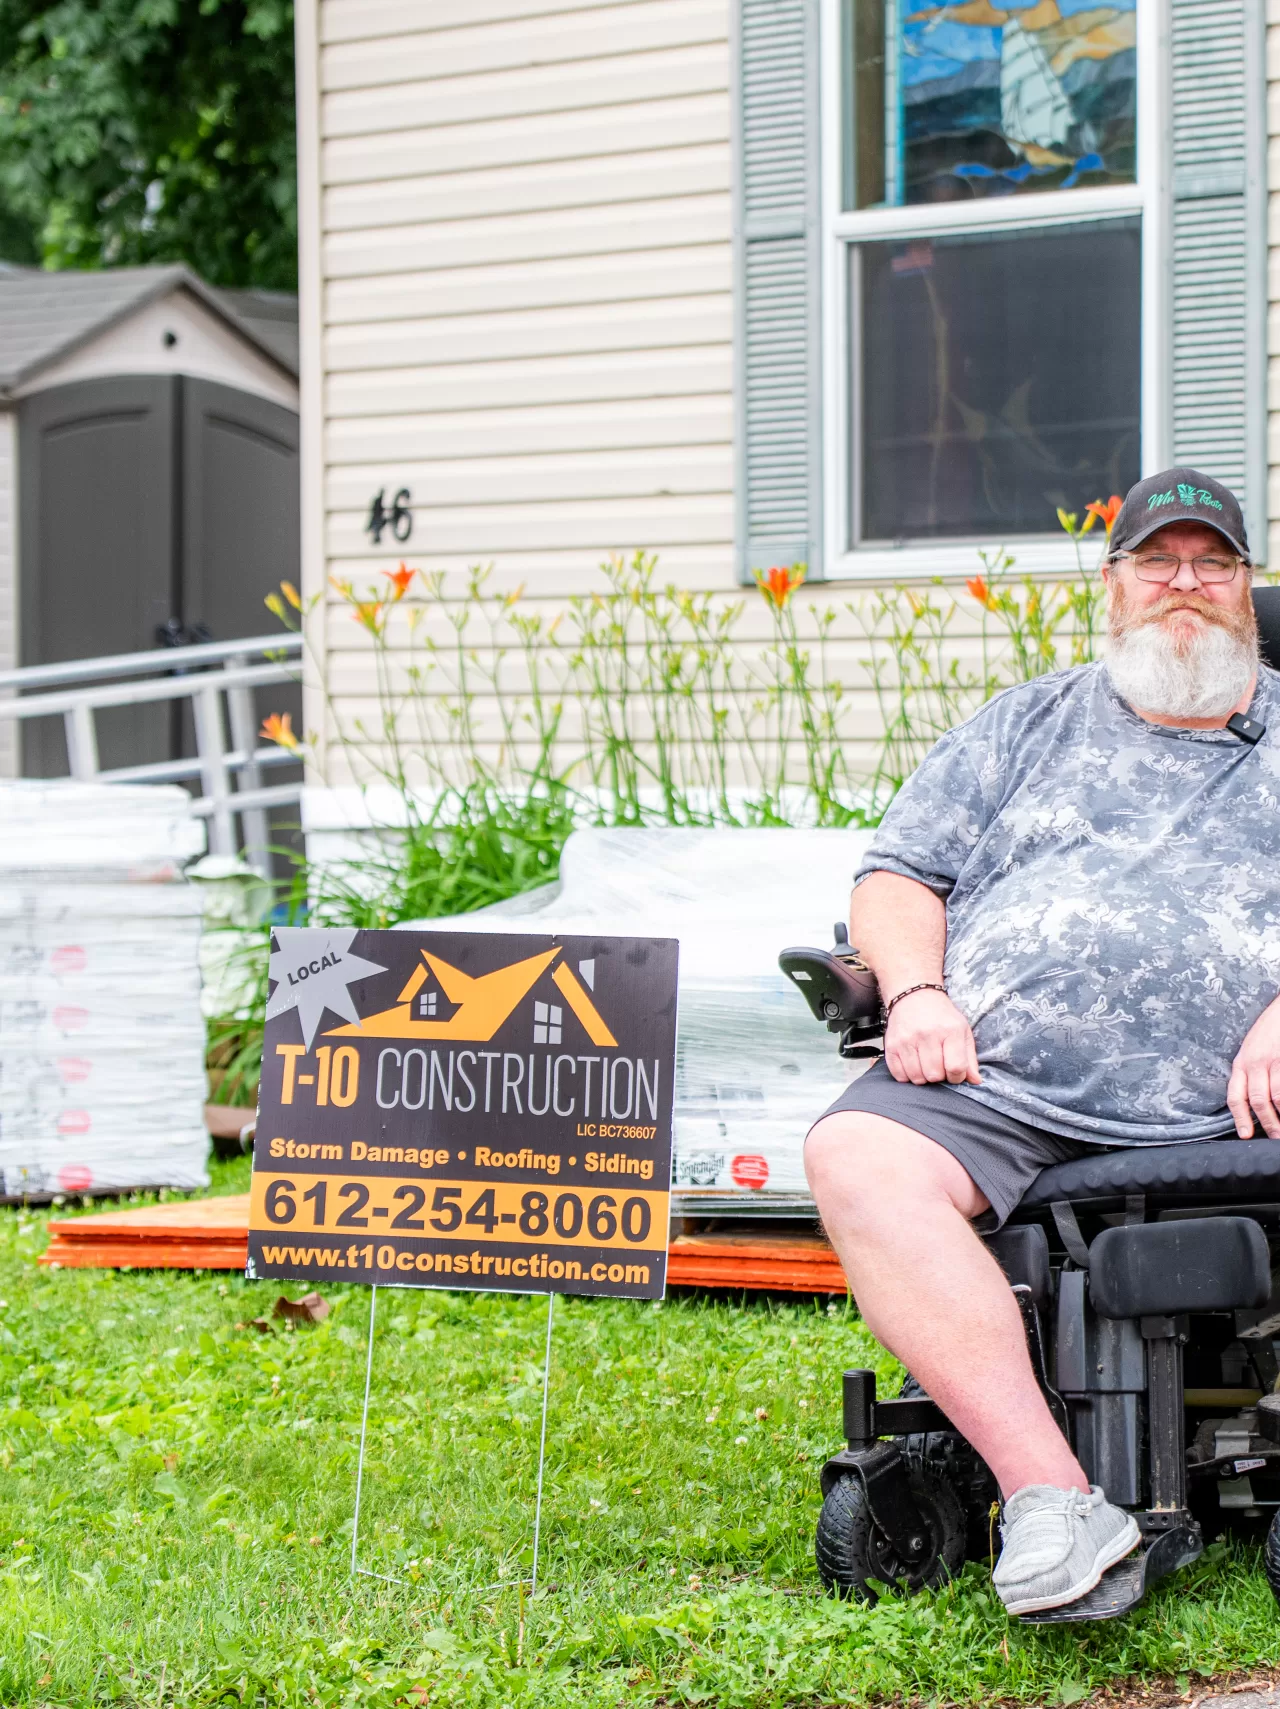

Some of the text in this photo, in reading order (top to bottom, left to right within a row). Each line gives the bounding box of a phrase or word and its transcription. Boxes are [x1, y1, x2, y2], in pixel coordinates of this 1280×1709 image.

[287, 951, 342, 986] LOCAL
[275, 1043, 660, 1121] T-10 CONSTRUCTION
[577, 1123, 657, 1140] LIC BC736607
[269, 1137, 655, 1180] Storm Damage Roofing Siding
[264, 1179, 651, 1242] 612-254-8060
[262, 1244, 650, 1284] www.t10construction.com
